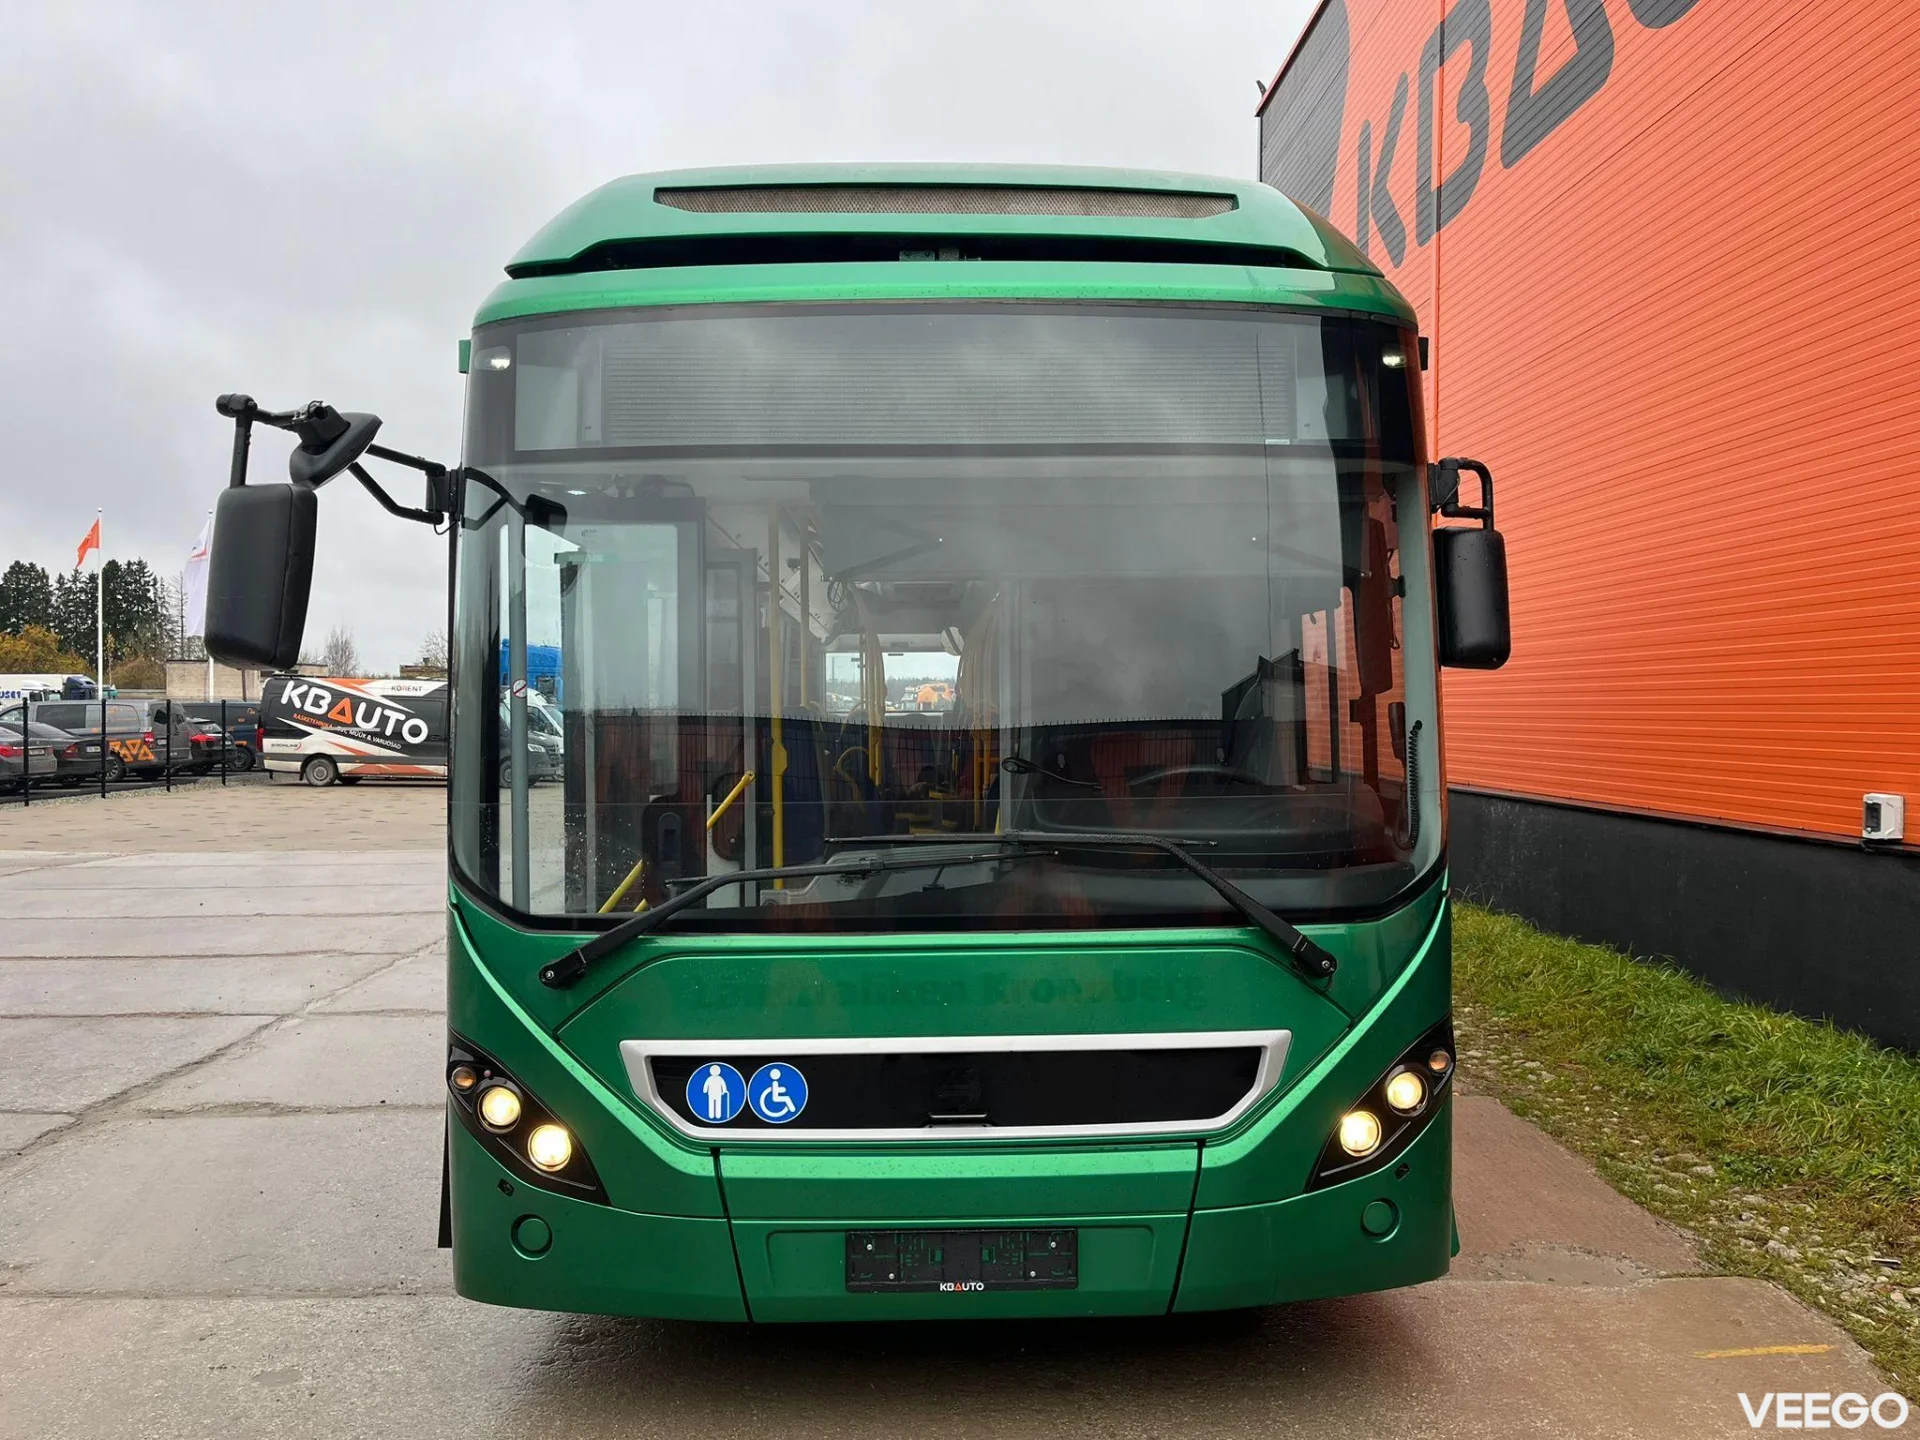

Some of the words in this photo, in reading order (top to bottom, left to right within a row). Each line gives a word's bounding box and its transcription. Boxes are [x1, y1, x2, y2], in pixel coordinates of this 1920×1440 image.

[1356, 0, 1697, 269] KBA
[391, 684, 423, 692] KORENT
[280, 680, 429, 744] KBAUTO
[939, 1282, 984, 1292] KBAUTO
